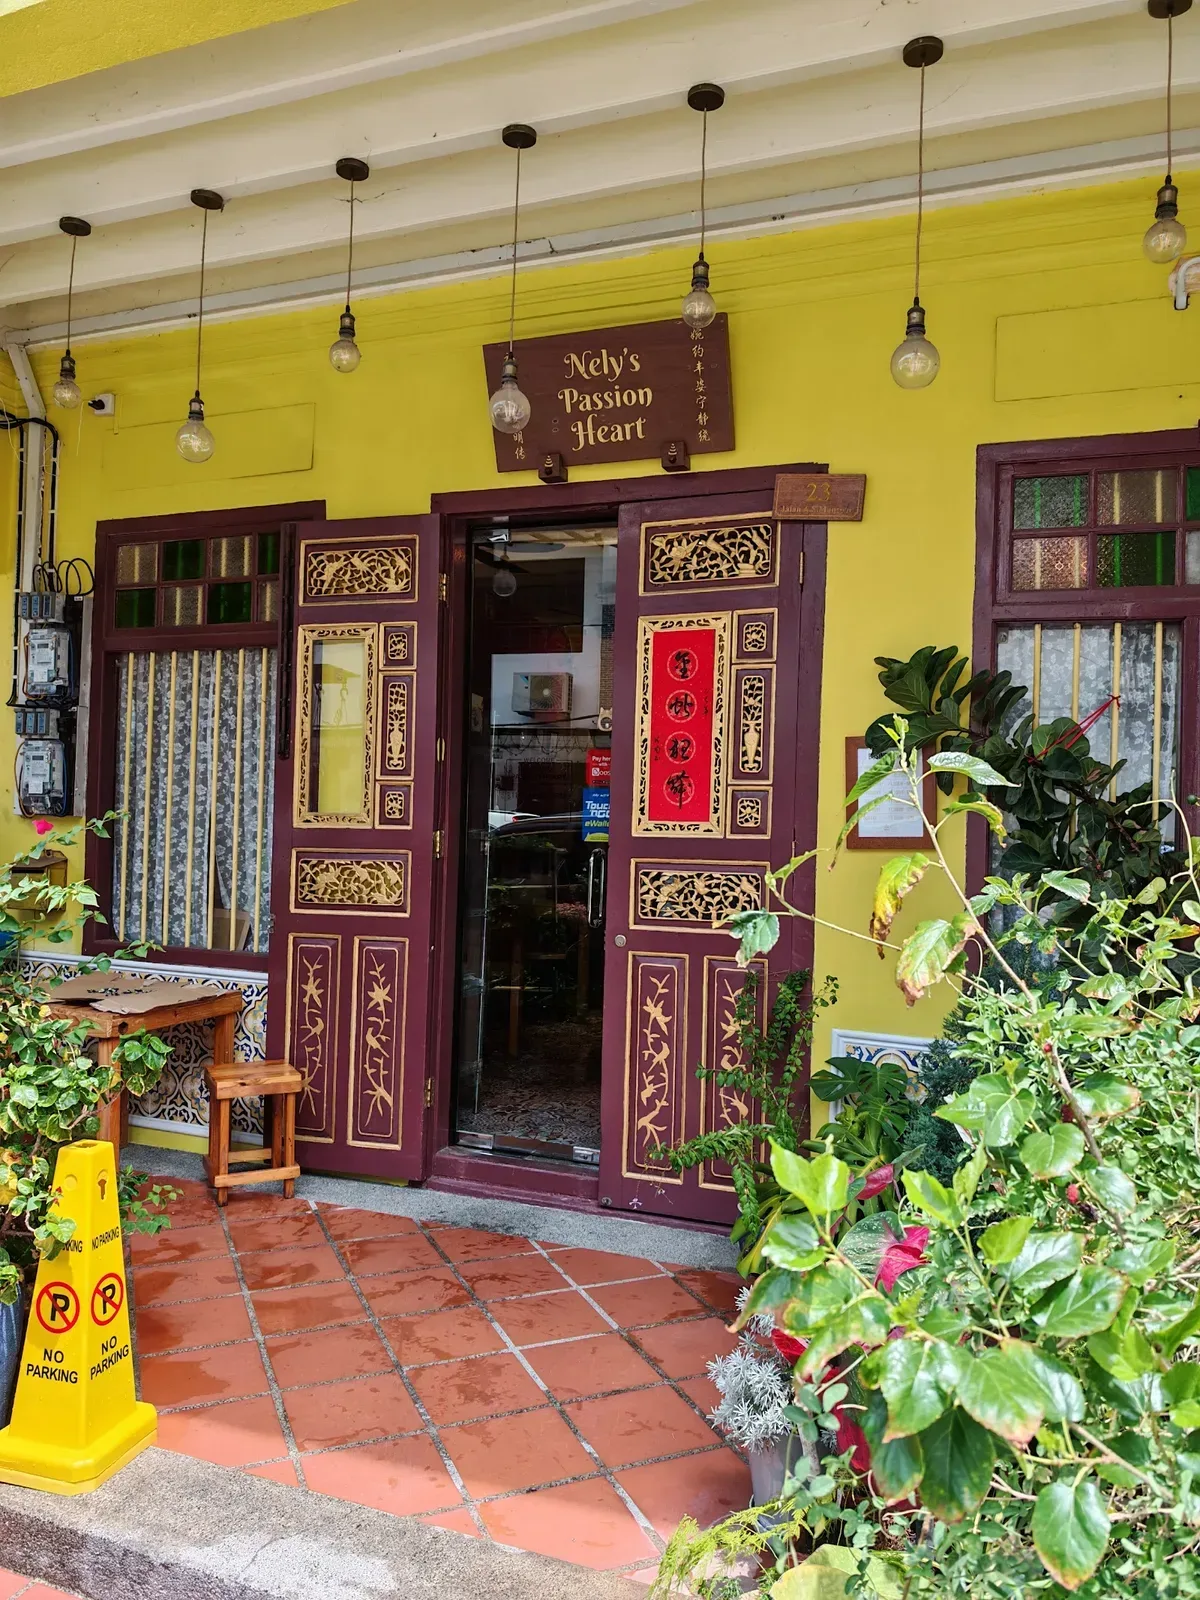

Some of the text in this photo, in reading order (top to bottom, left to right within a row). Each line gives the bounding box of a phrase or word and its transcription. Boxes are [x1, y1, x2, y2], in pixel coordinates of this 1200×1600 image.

[563, 347, 641, 382] Nely's
[557, 384, 653, 413] Passion
[570, 413, 646, 451] Heart
[806, 482, 832, 502] 23
[591, 755, 601, 763] Pay
[585, 800, 610, 810] Touc
[584, 819, 610, 827] eWalle
[92, 1226, 120, 1250] NO PARKING
[101, 1335, 118, 1355] NO
[43, 1348, 65, 1363] NO
[90, 1344, 130, 1380] PARKING
[26, 1363, 78, 1384] PARKING
